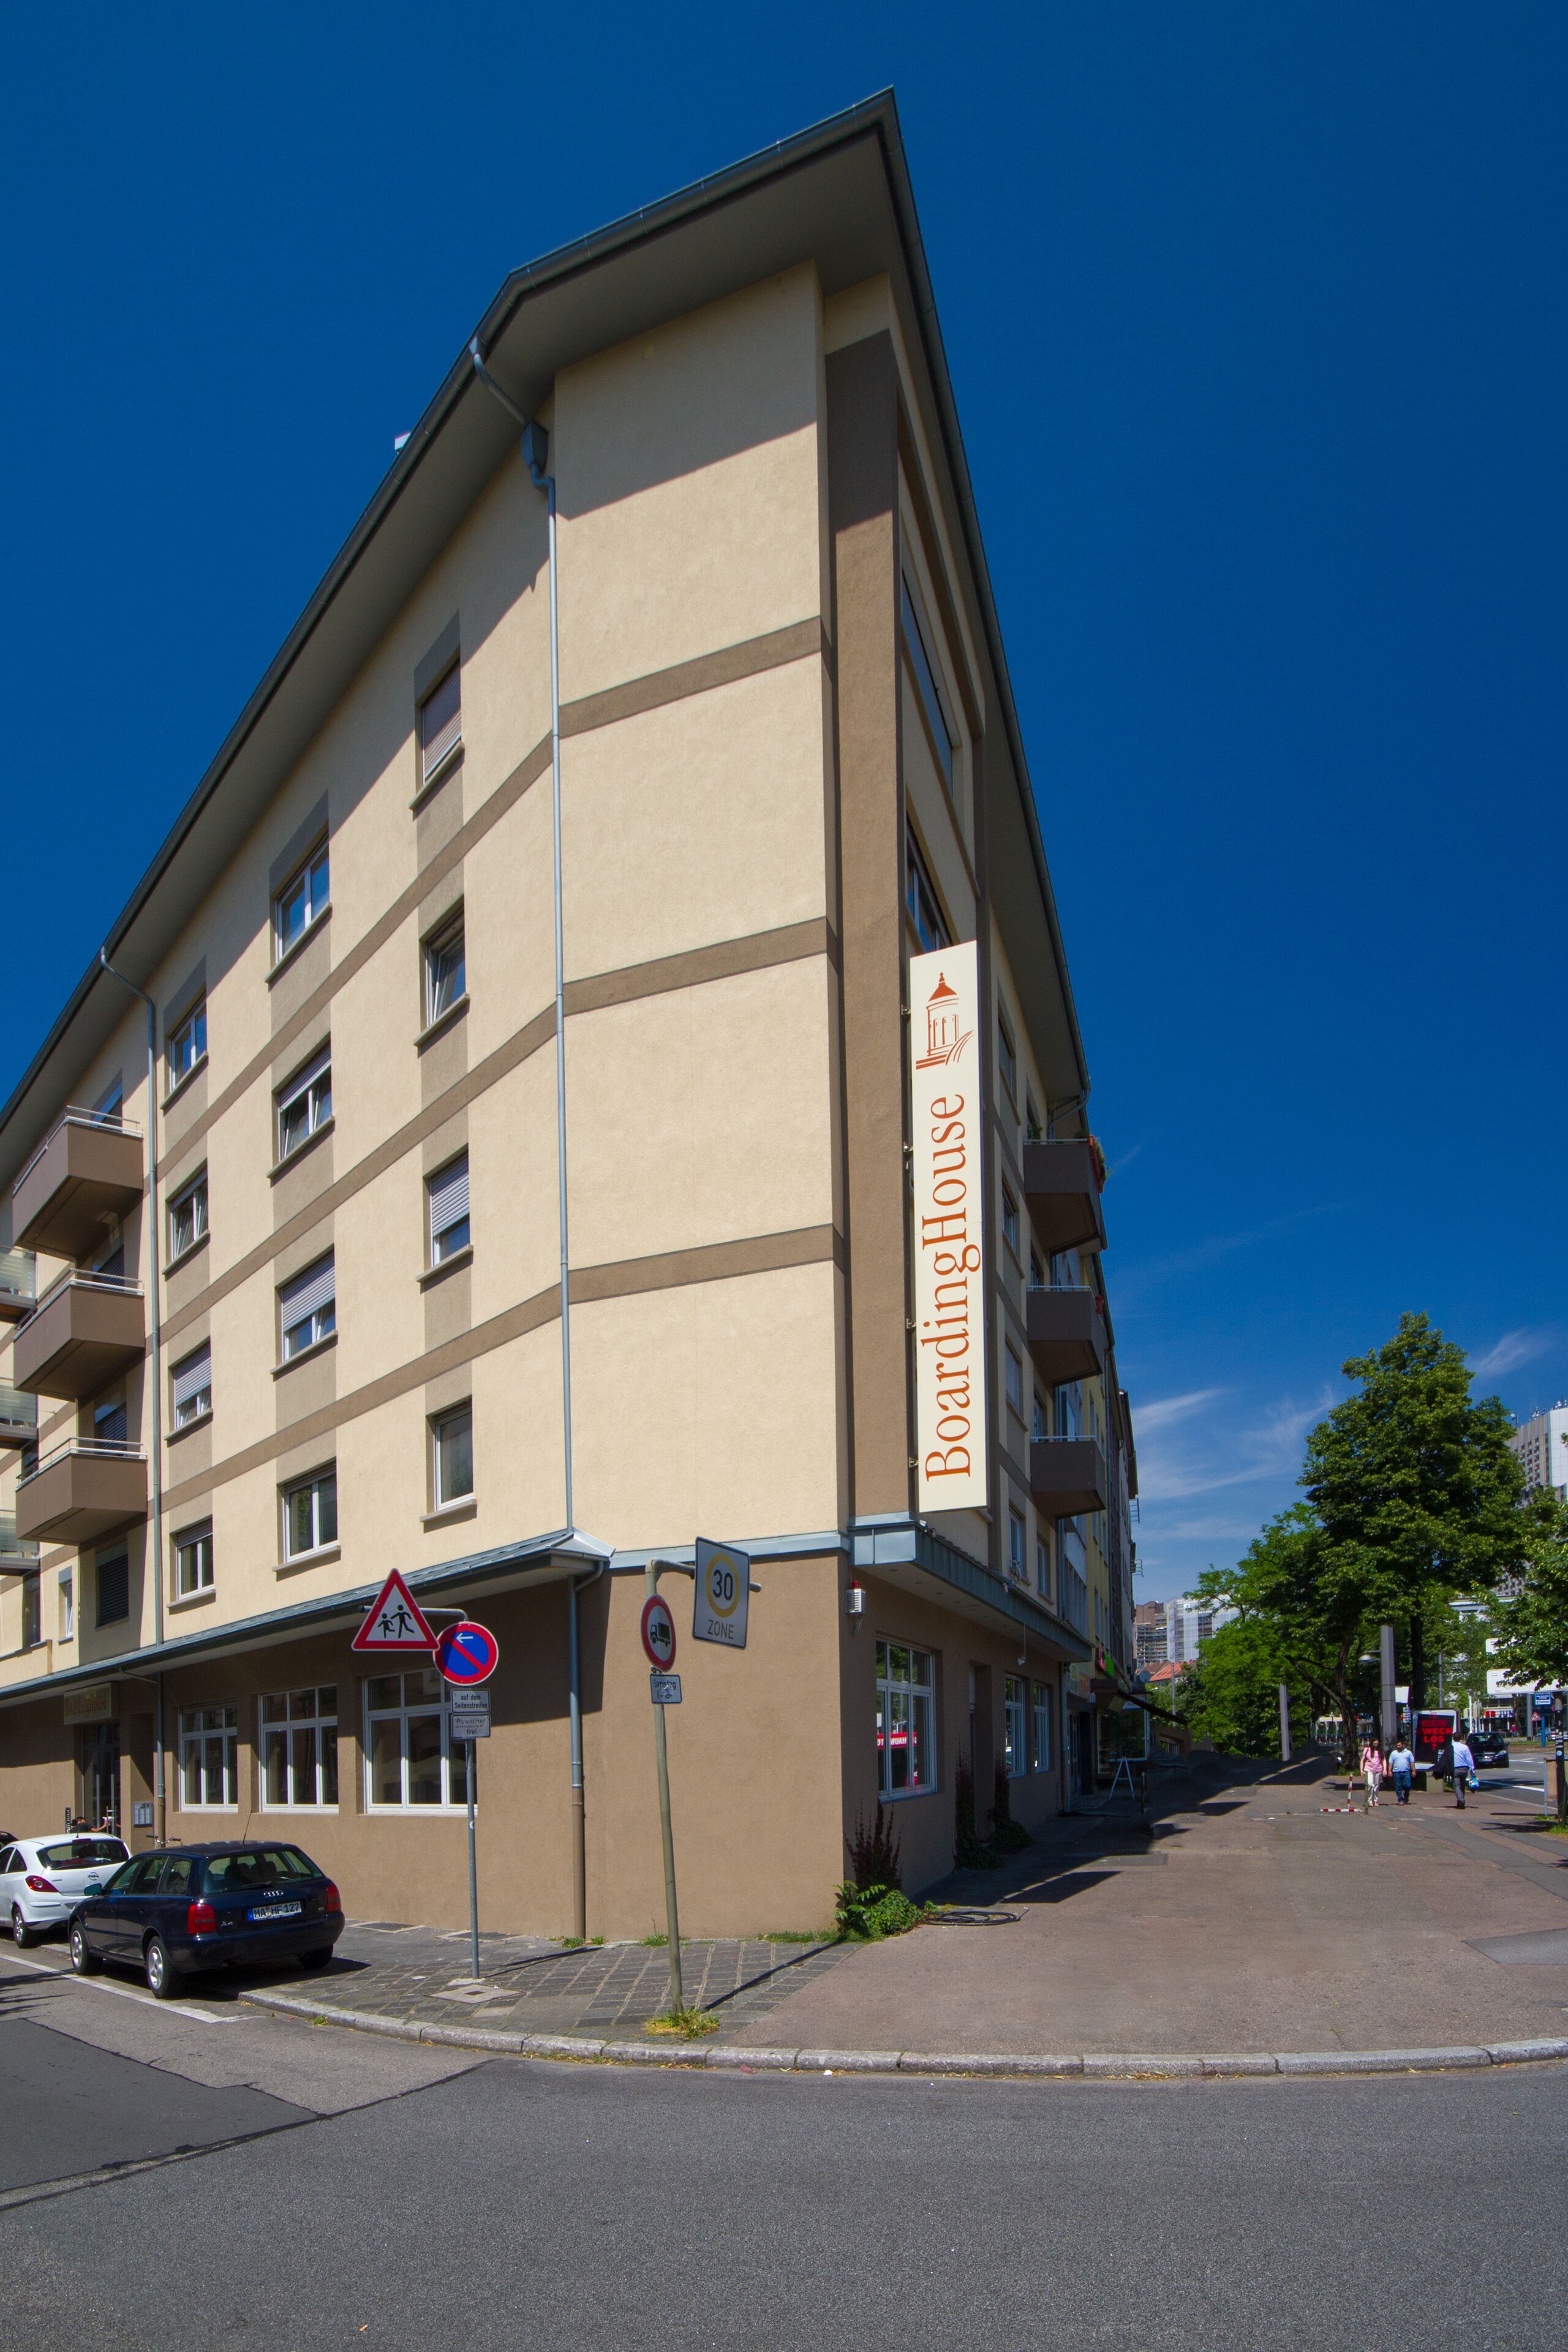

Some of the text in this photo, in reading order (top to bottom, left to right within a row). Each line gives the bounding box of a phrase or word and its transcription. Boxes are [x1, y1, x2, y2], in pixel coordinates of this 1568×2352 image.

[920, 1093, 981, 1482] BoardingHouse
[712, 1569, 733, 1600] 30
[707, 1619, 735, 1639] ZONE
[254, 1908, 265, 1918] MA
[284, 1902, 300, 1913] 127
